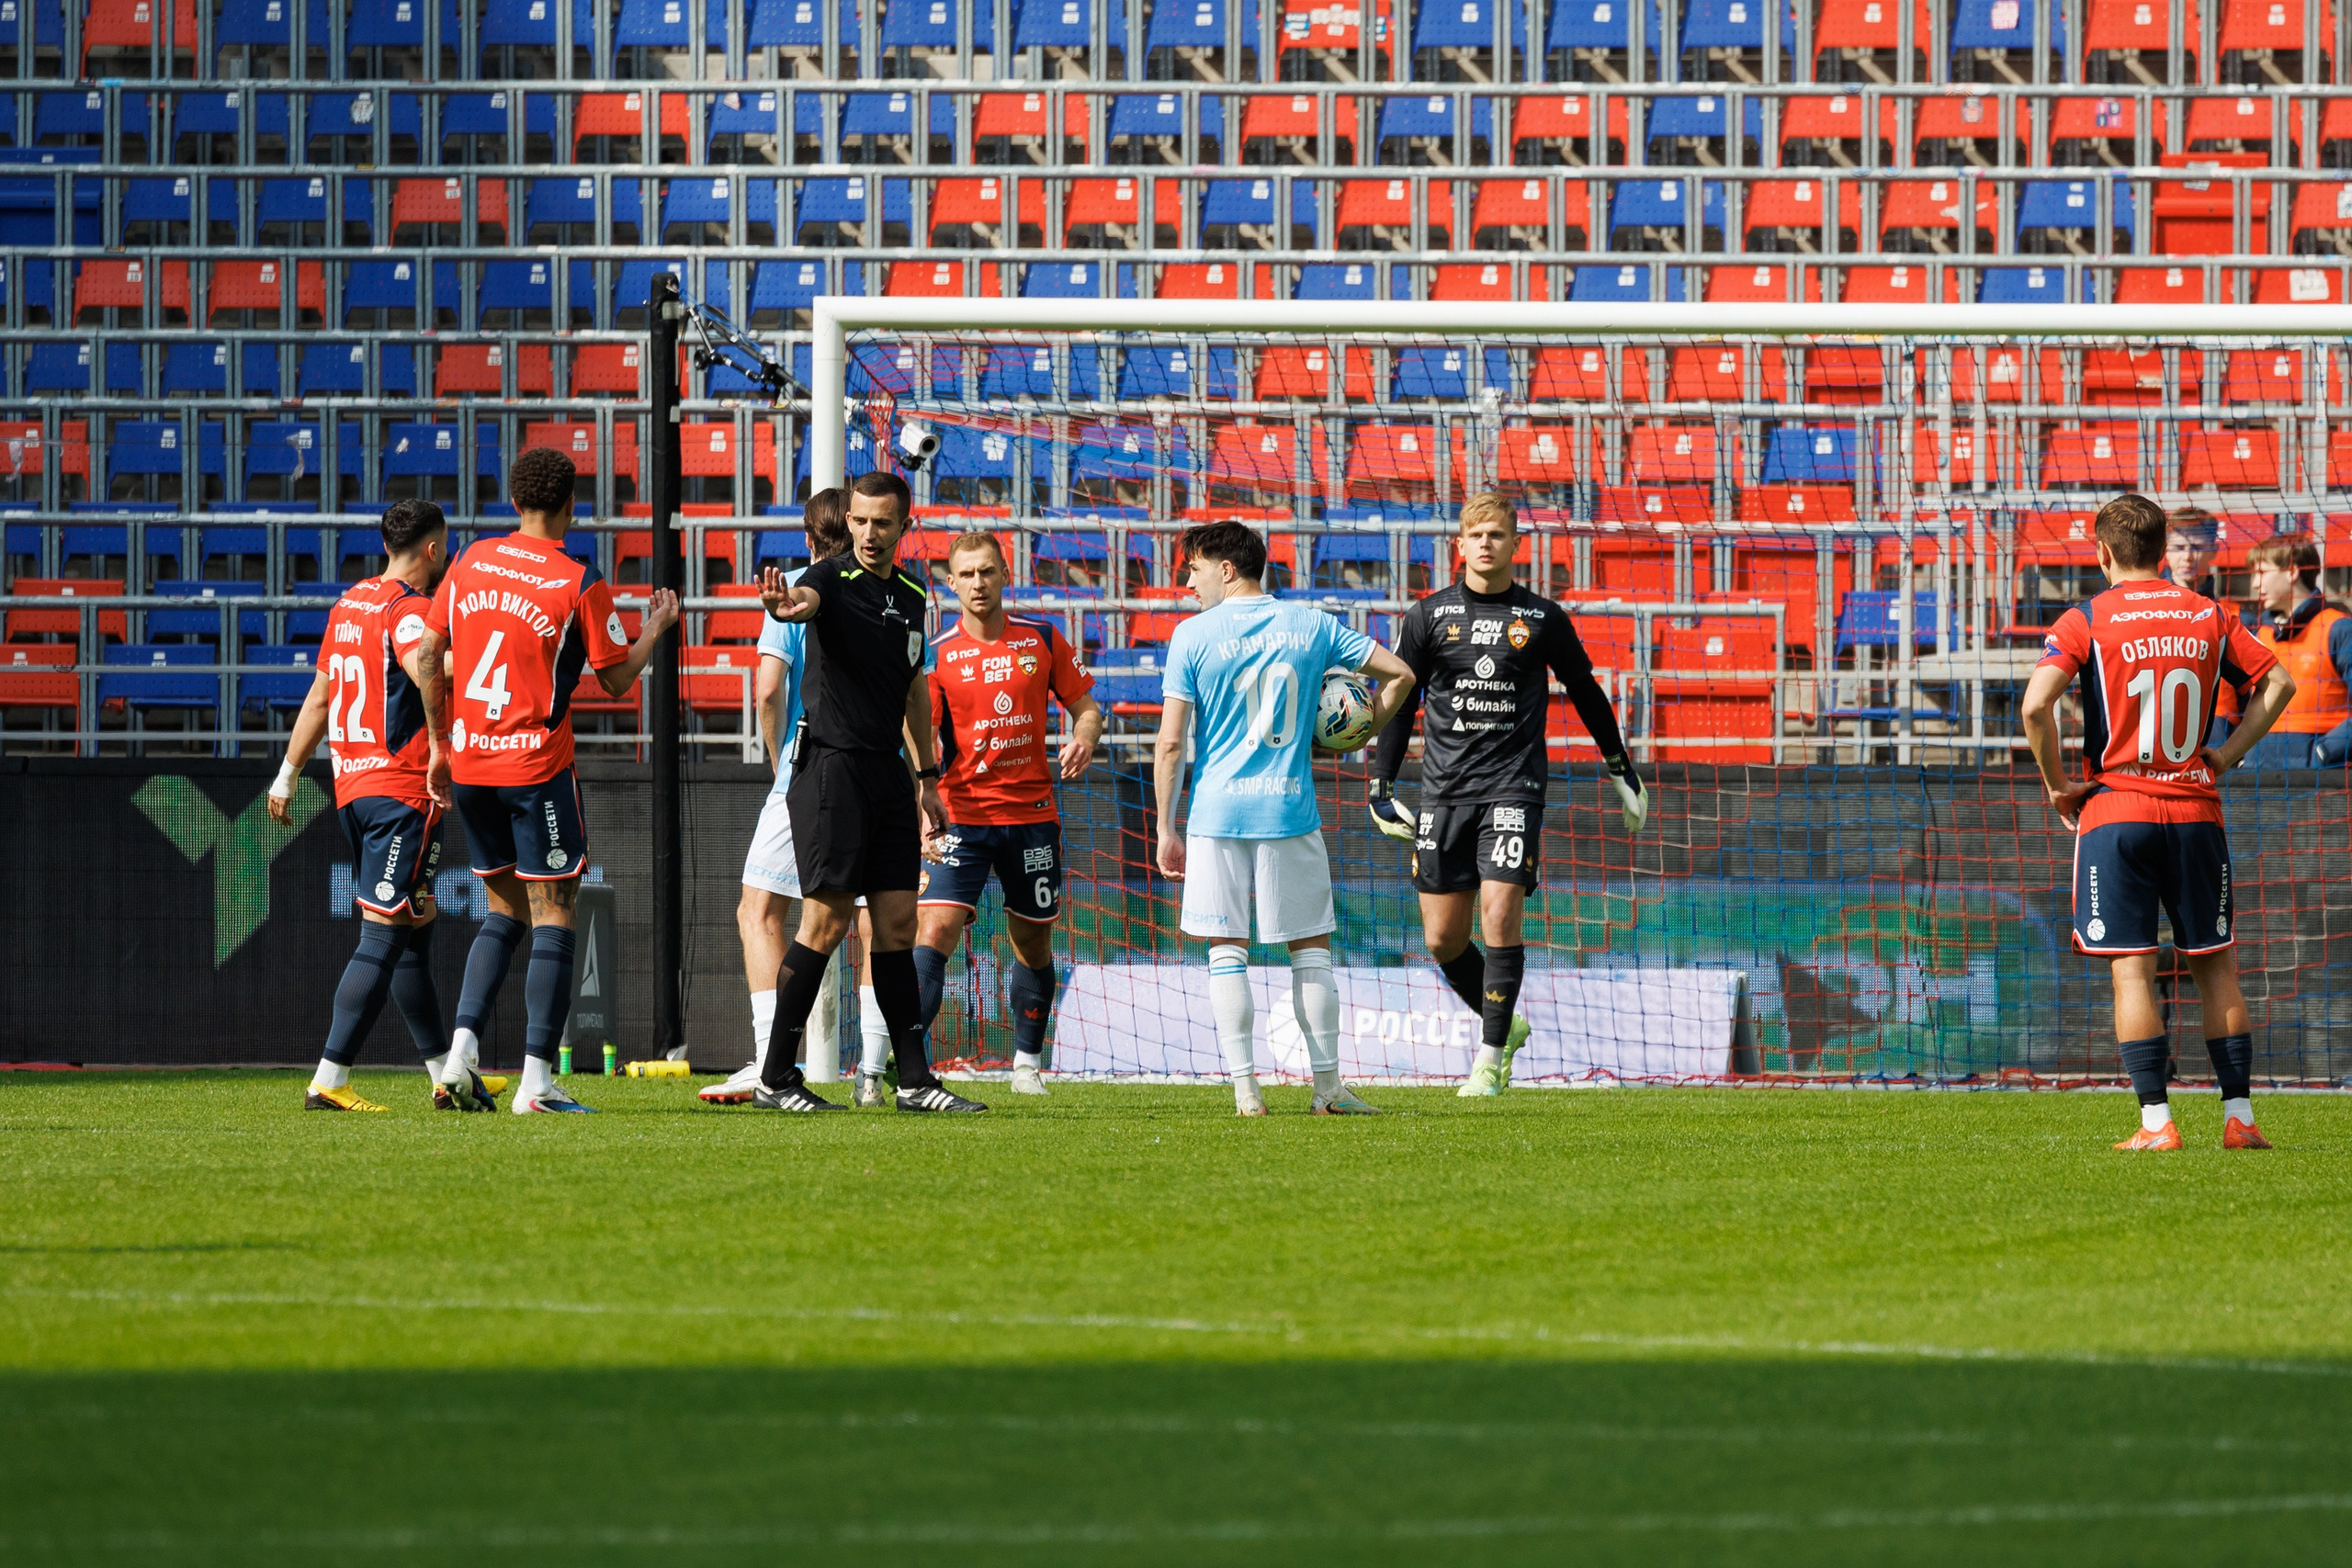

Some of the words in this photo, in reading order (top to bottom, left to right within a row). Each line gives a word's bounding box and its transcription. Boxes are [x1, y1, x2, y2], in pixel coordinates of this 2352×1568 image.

[470, 561, 546, 585] АЭРОФЛОТ
[457, 590, 498, 620] ЖОАО
[501, 592, 556, 637] ВИКТОР
[1445, 605, 1466, 615] ПСБ
[2110, 610, 2194, 624] АЭРОФЛОТ
[1471, 619, 1503, 633] FON
[1217, 631, 1310, 660] КРАМАРИЧ
[1471, 632, 1502, 645] BET
[959, 648, 980, 660] ПСБ
[2121, 636, 2210, 663] ОБЛЯКОВ
[982, 655, 1012, 671] FON
[465, 630, 513, 721] 4
[984, 668, 1013, 683] BET
[1455, 680, 1516, 692] APOTHEKA
[329, 653, 377, 744] 22
[1233, 662, 1299, 750] 10
[1466, 696, 1516, 713] билайн
[974, 714, 1033, 730] APOTHEKA
[2127, 667, 2201, 764] 10
[469, 733, 541, 751] РОССЕТИ
[990, 734, 1033, 750] билайн
[343, 756, 390, 773] ОССЕТИ
[1238, 778, 1264, 795] SMP
[1264, 777, 1301, 795] RACING
[1494, 807, 1525, 820] ВЭБ
[545, 801, 560, 847] РОССЕТИ
[384, 836, 402, 881] РОССЕТИ
[1023, 845, 1053, 860] ВЭБ
[1491, 835, 1523, 869] 49
[1035, 876, 1052, 908] 6
[2090, 865, 2100, 916] РОССЕТИ
[2218, 863, 2228, 913] РОССЕТИ
